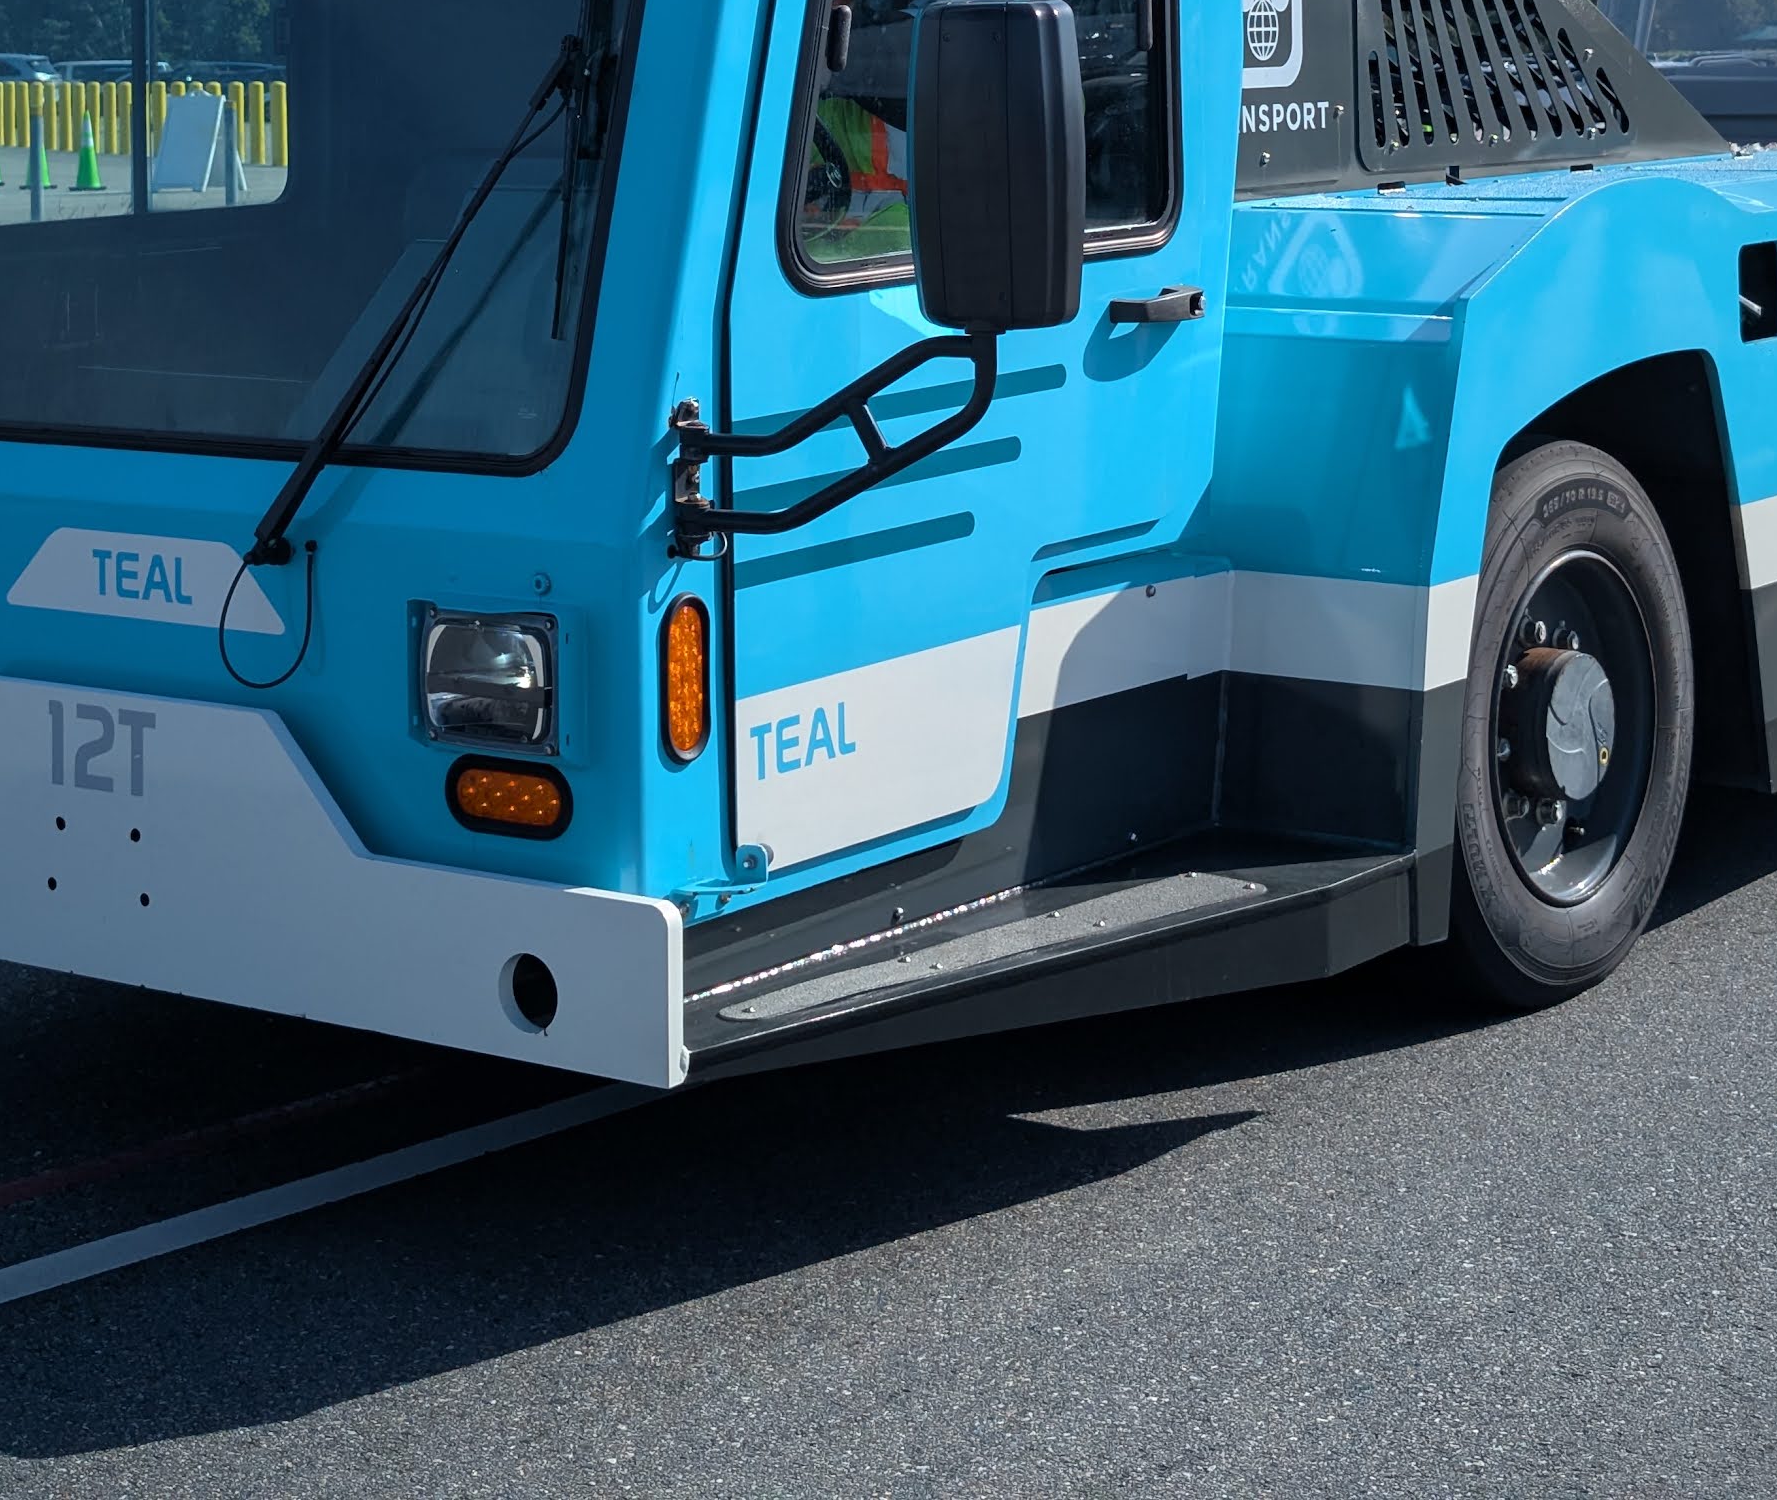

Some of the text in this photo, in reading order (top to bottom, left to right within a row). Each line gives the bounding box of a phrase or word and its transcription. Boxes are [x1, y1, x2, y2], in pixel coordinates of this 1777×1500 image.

[1240, 101, 1329, 134] NSPORT
[92, 549, 193, 605] TEAL
[48, 700, 156, 796] 12T
[750, 701, 856, 780] TEAL
